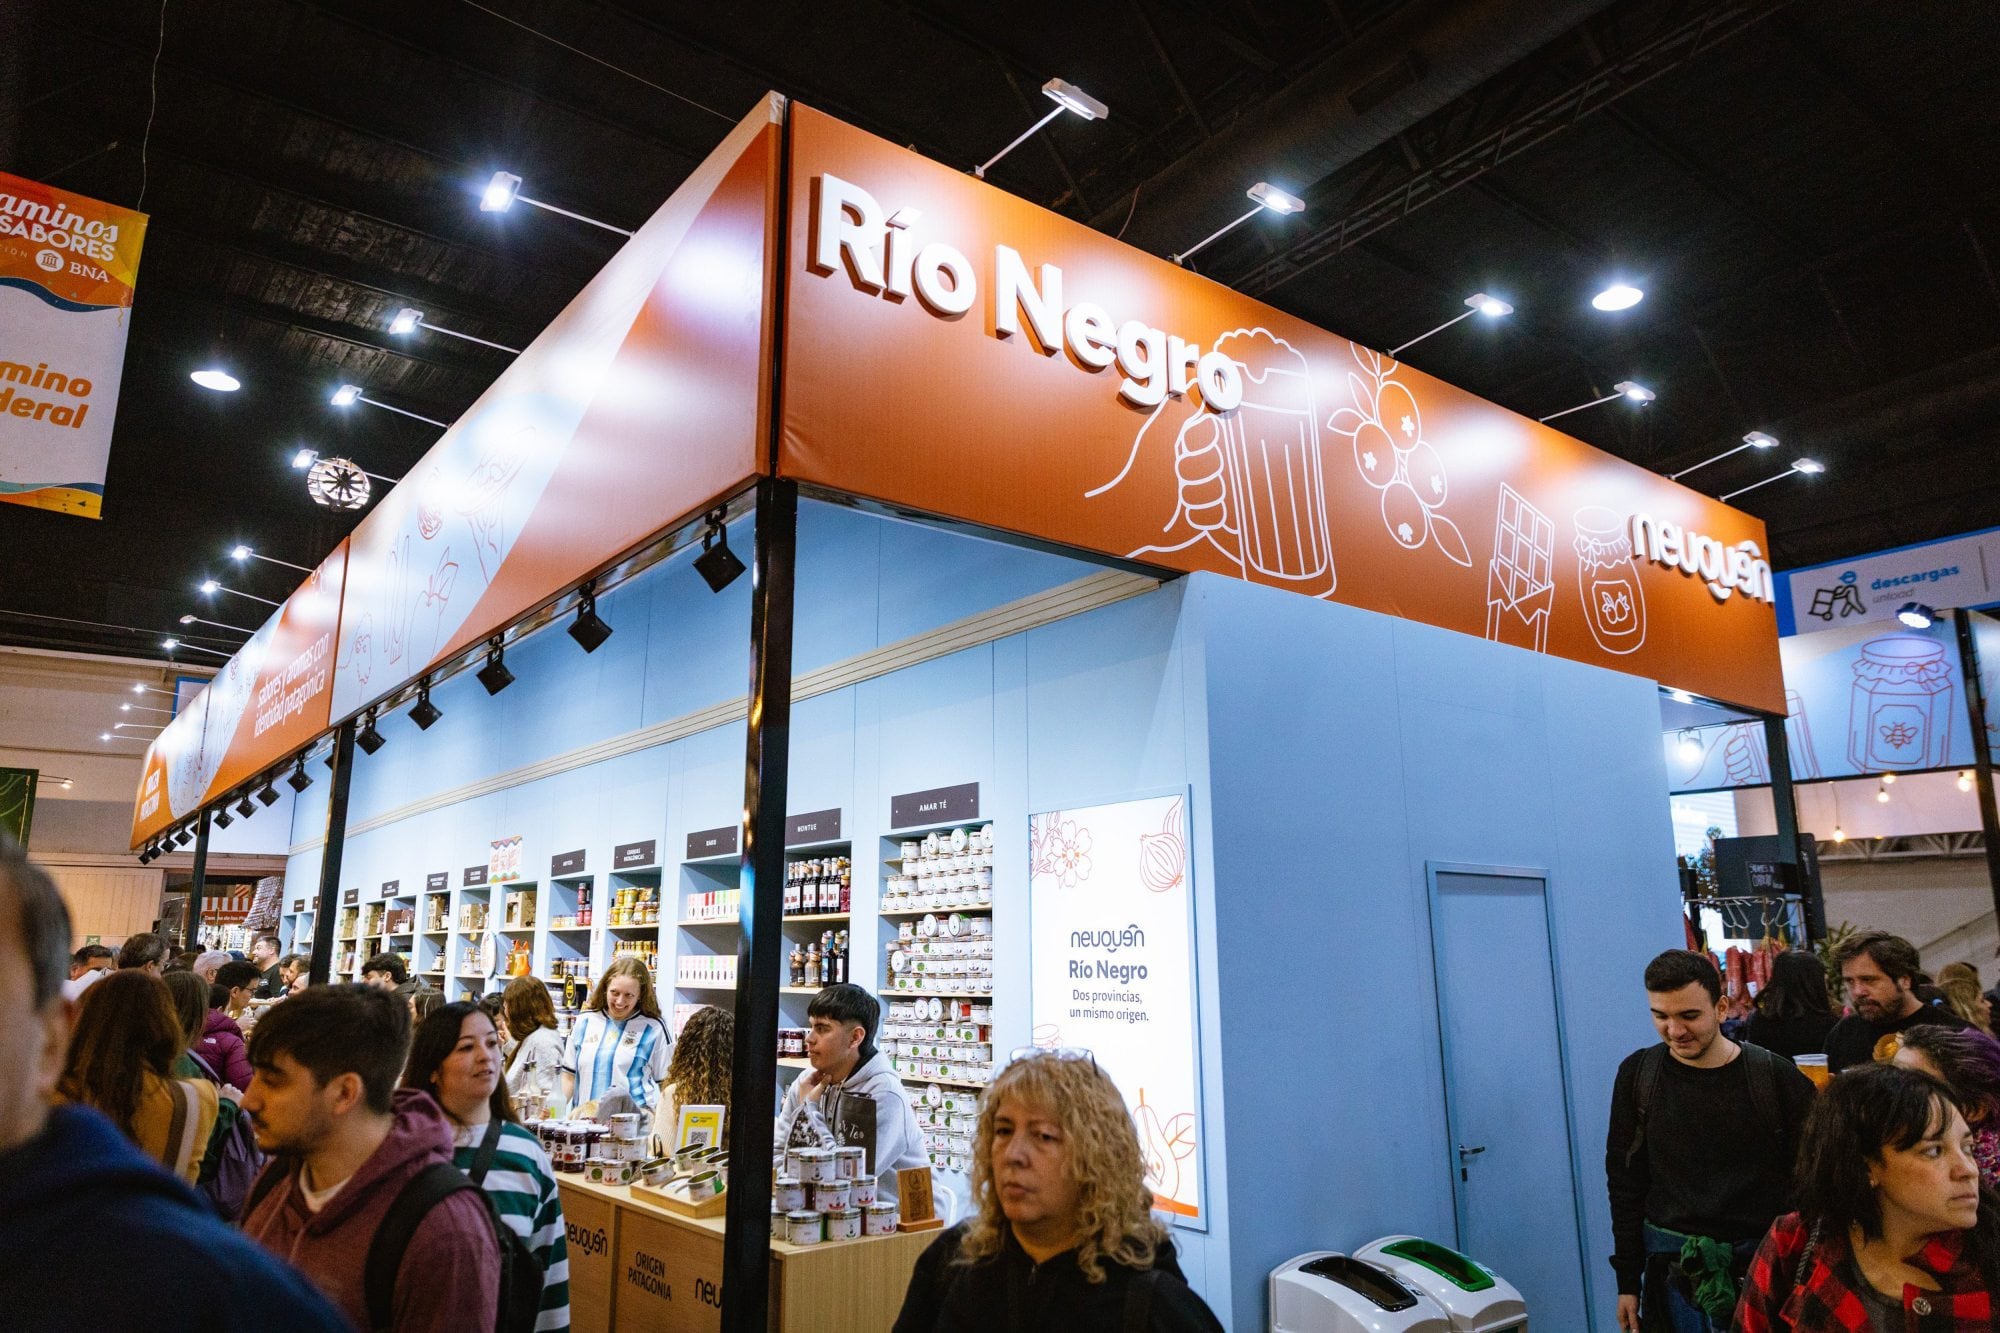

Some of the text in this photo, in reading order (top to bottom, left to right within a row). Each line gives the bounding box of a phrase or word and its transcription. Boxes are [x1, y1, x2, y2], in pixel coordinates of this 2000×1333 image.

[0, 215, 115, 261] SABORES
[69, 261, 110, 283] BNA
[817, 172, 1243, 411] Río Negro
[1872, 565, 1959, 590] descargas
[1872, 588, 1915, 603] unload
[258, 673, 282, 708] sabores
[314, 632, 329, 662] con
[919, 799, 947, 812] AMAR TÉ
[1069, 960, 1148, 984] Río Negro
[1073, 989, 1143, 1005] Dos provincias,
[1069, 1006, 1149, 1024] un mismo origen.
[635, 1251, 666, 1278] ORIGEN
[628, 1267, 672, 1301] PATAGONIA
